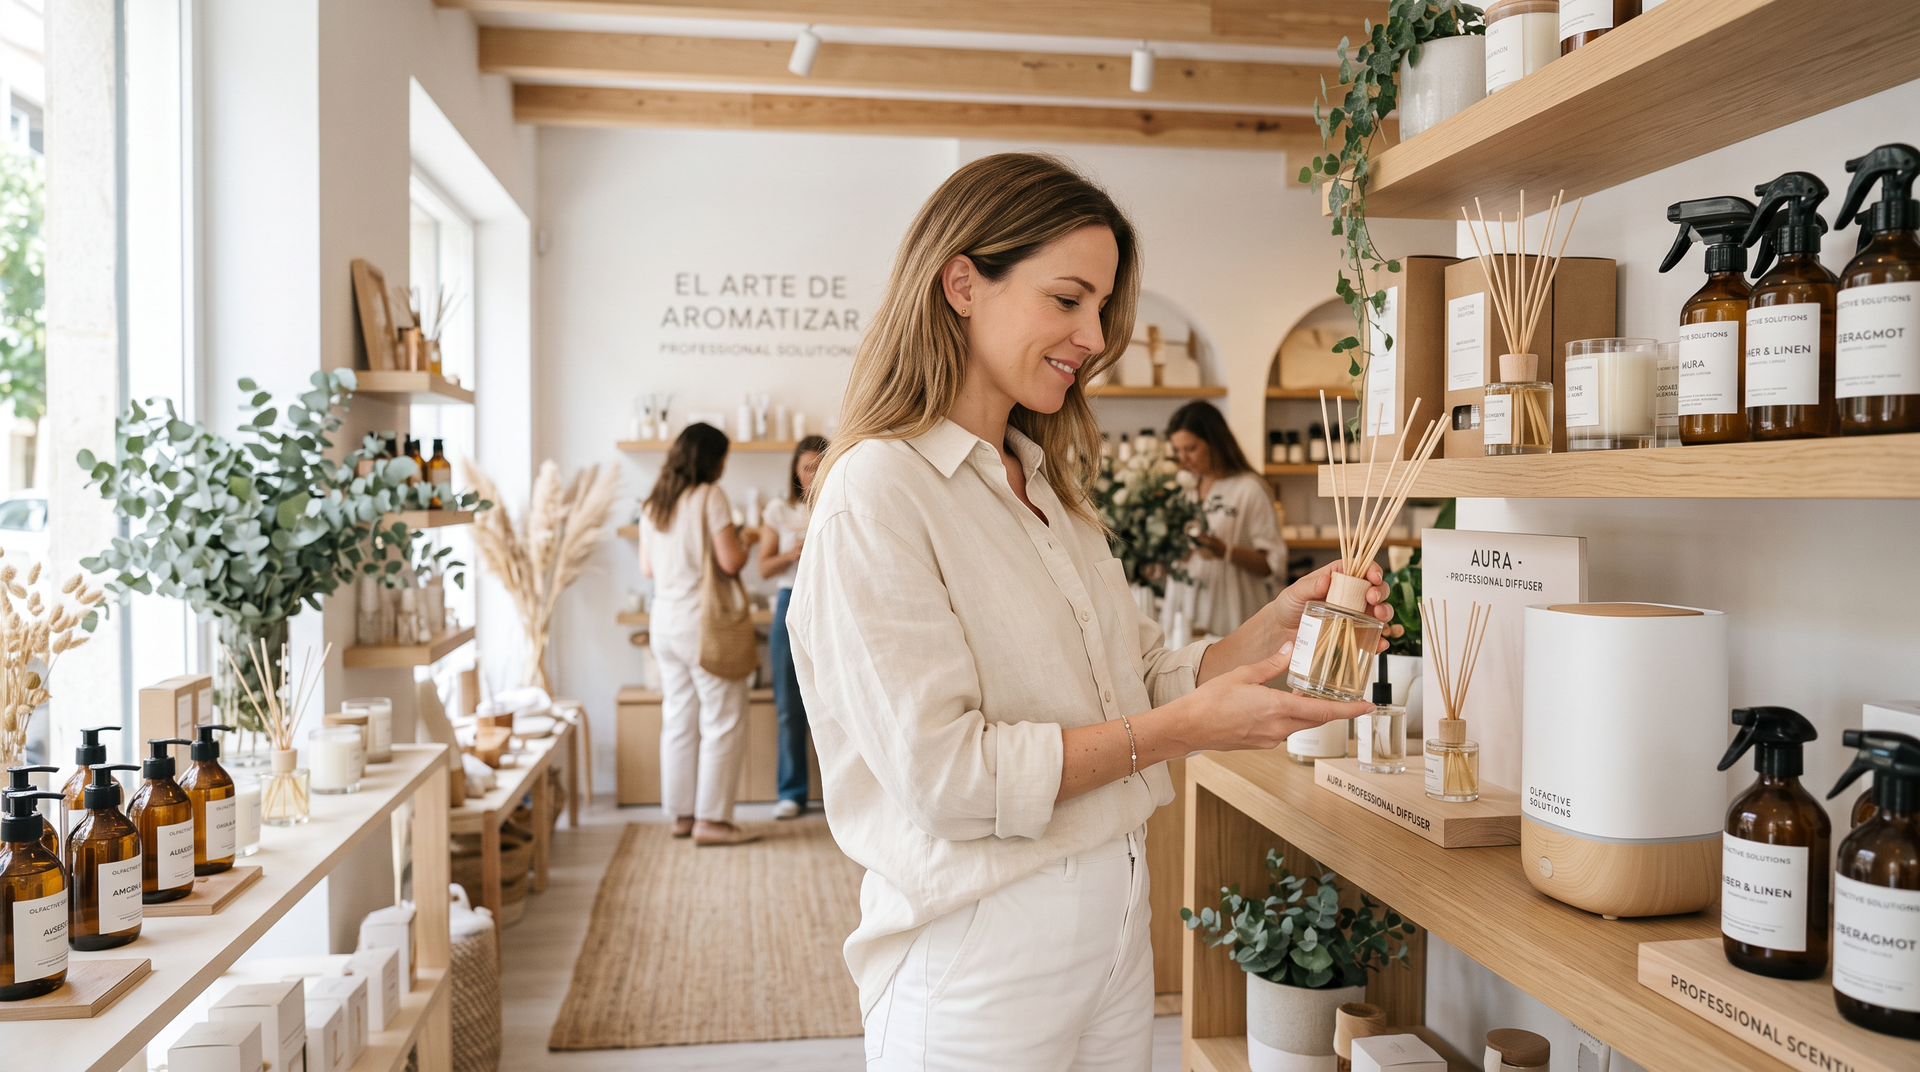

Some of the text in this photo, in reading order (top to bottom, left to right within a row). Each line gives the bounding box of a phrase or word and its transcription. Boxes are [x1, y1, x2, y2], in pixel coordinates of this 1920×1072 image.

[675, 273, 848, 299] EL ARTE DE
[1861, 294, 1911, 305] SOLUTIONS
[661, 305, 861, 331] AROMATIZAR
[1764, 314, 1808, 324] SOLUTIONS
[1691, 331, 1728, 340] SOLUTIONS
[659, 343, 771, 358] PROFESSIONAL
[1763, 346, 1770, 356] &
[1774, 344, 1811, 355] LINEN
[1471, 549, 1512, 570] AURA
[1450, 572, 1503, 587] PROFESSIONAL
[1505, 578, 1543, 592] DIFFUSER
[1326, 774, 1343, 788] AURA
[1347, 783, 1395, 815] PROFESSIONAL
[1396, 806, 1431, 832] DIFFUSER
[1529, 786, 1571, 807] OLFACTIVE
[1529, 797, 1571, 818] SOLUTIONS
[1746, 852, 1791, 865] SOLUTIONS
[1743, 882, 1750, 892] &
[1754, 884, 1792, 899] LINEN
[1670, 973, 1783, 1047] PROFESSIONAL
